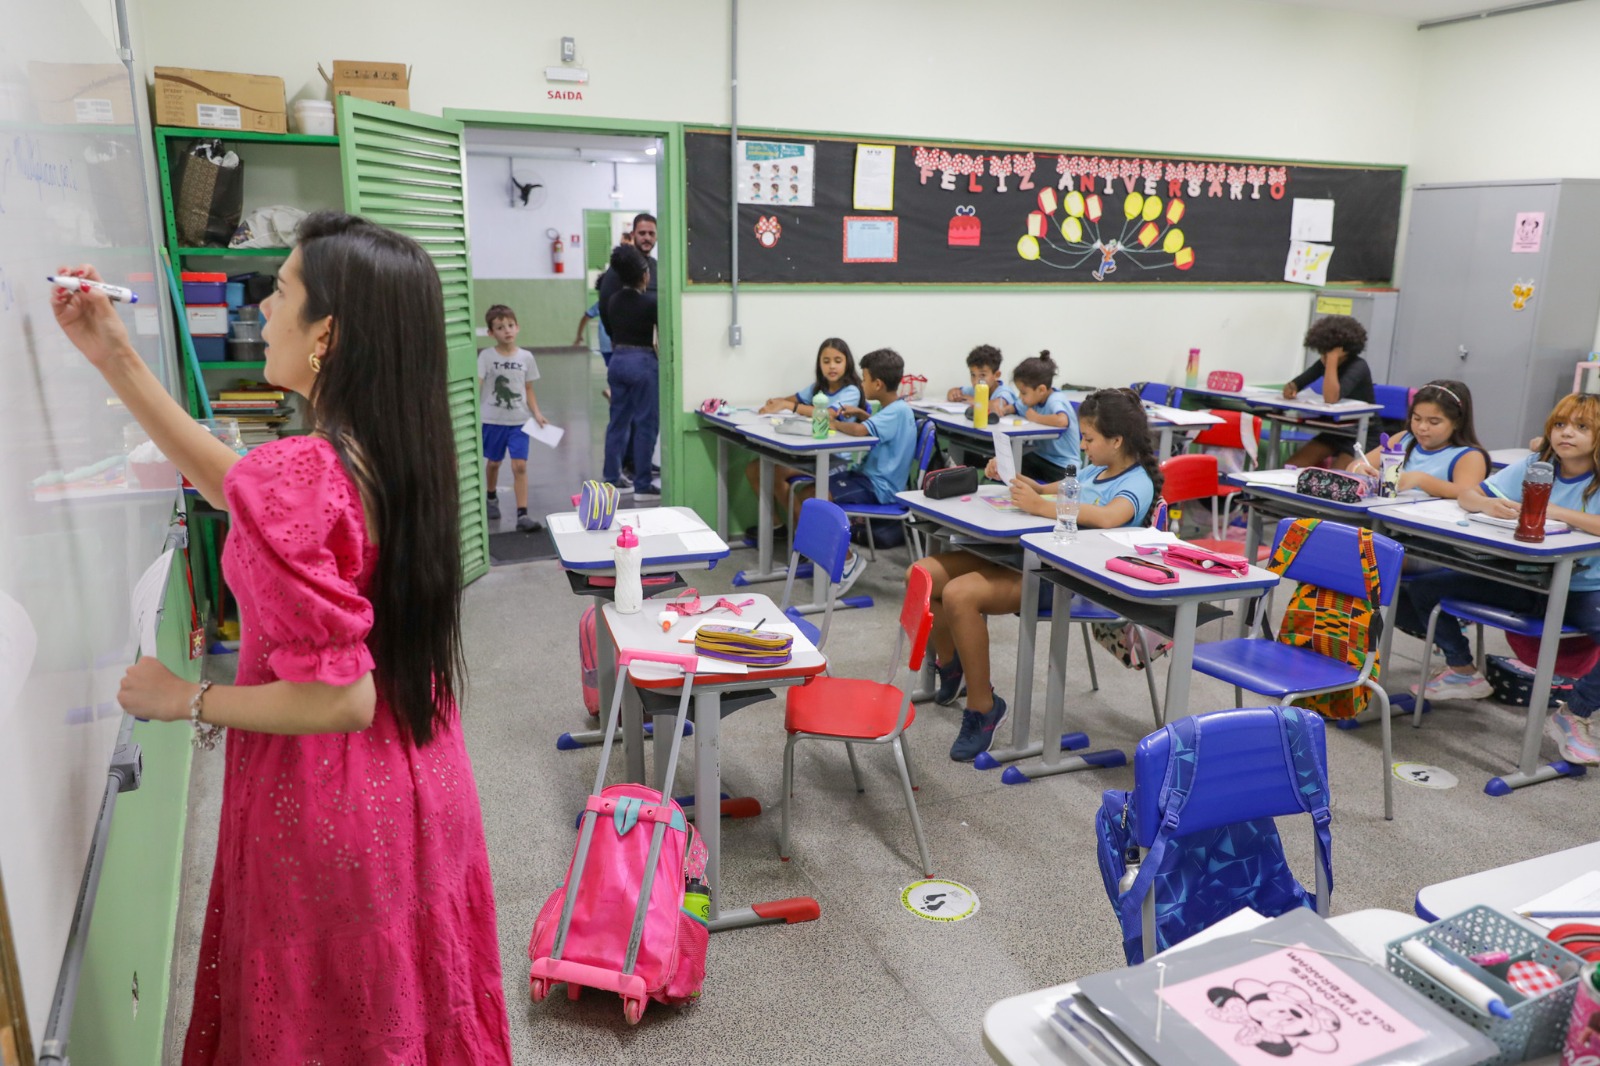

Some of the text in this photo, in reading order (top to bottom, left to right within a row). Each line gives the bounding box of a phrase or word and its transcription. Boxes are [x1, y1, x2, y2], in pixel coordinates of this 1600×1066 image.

[547, 90, 582, 100] SAÍDA
[920, 165, 1035, 192] FELIZ
[1286, 952, 1396, 1033] QUE SOBRARAM
[1289, 966, 1370, 1026] ATIVIDADES
